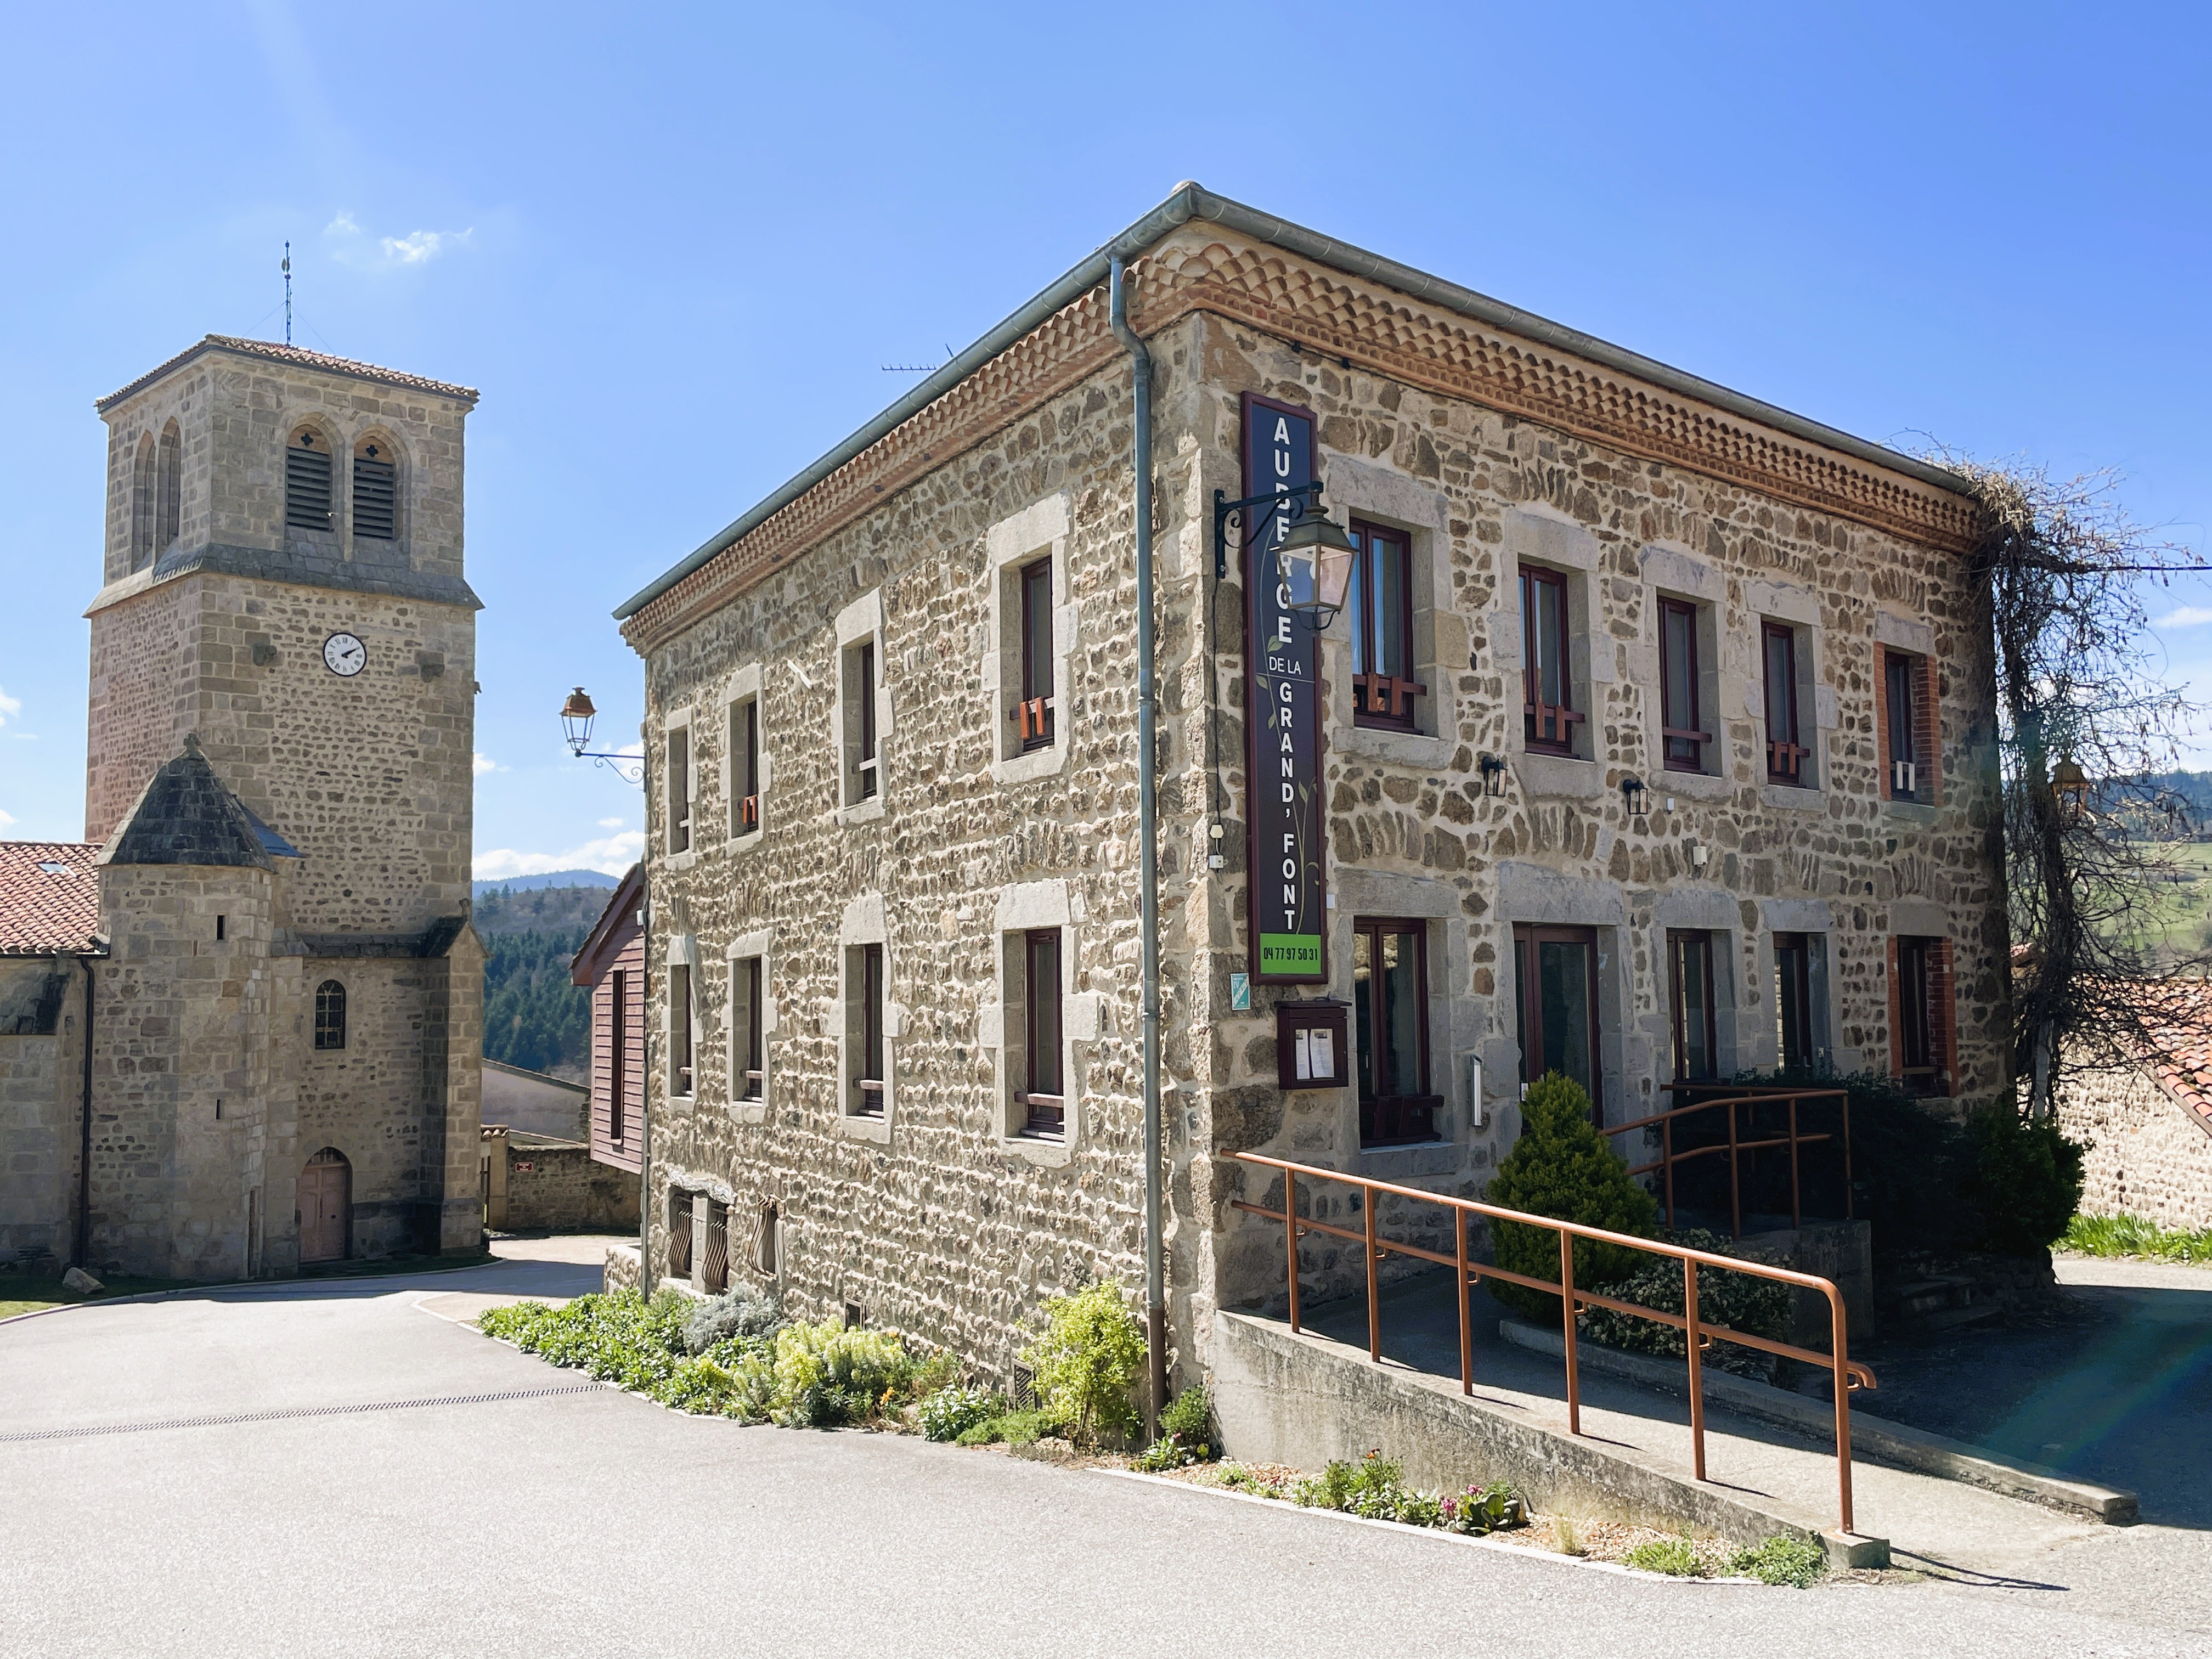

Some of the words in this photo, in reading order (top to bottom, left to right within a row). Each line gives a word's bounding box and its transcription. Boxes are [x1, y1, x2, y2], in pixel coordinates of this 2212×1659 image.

[1273, 417, 1293, 644] AUBERGE
[1269, 656, 1285, 673] DE
[1288, 659, 1302, 675] LA
[1283, 833, 1296, 930] FONT
[1263, 947, 1273, 960] 04
[1275, 947, 1284, 960] 77
[1286, 948, 1295, 960] 97
[1298, 948, 1307, 960] 50
[1309, 949, 1318, 961] 31
